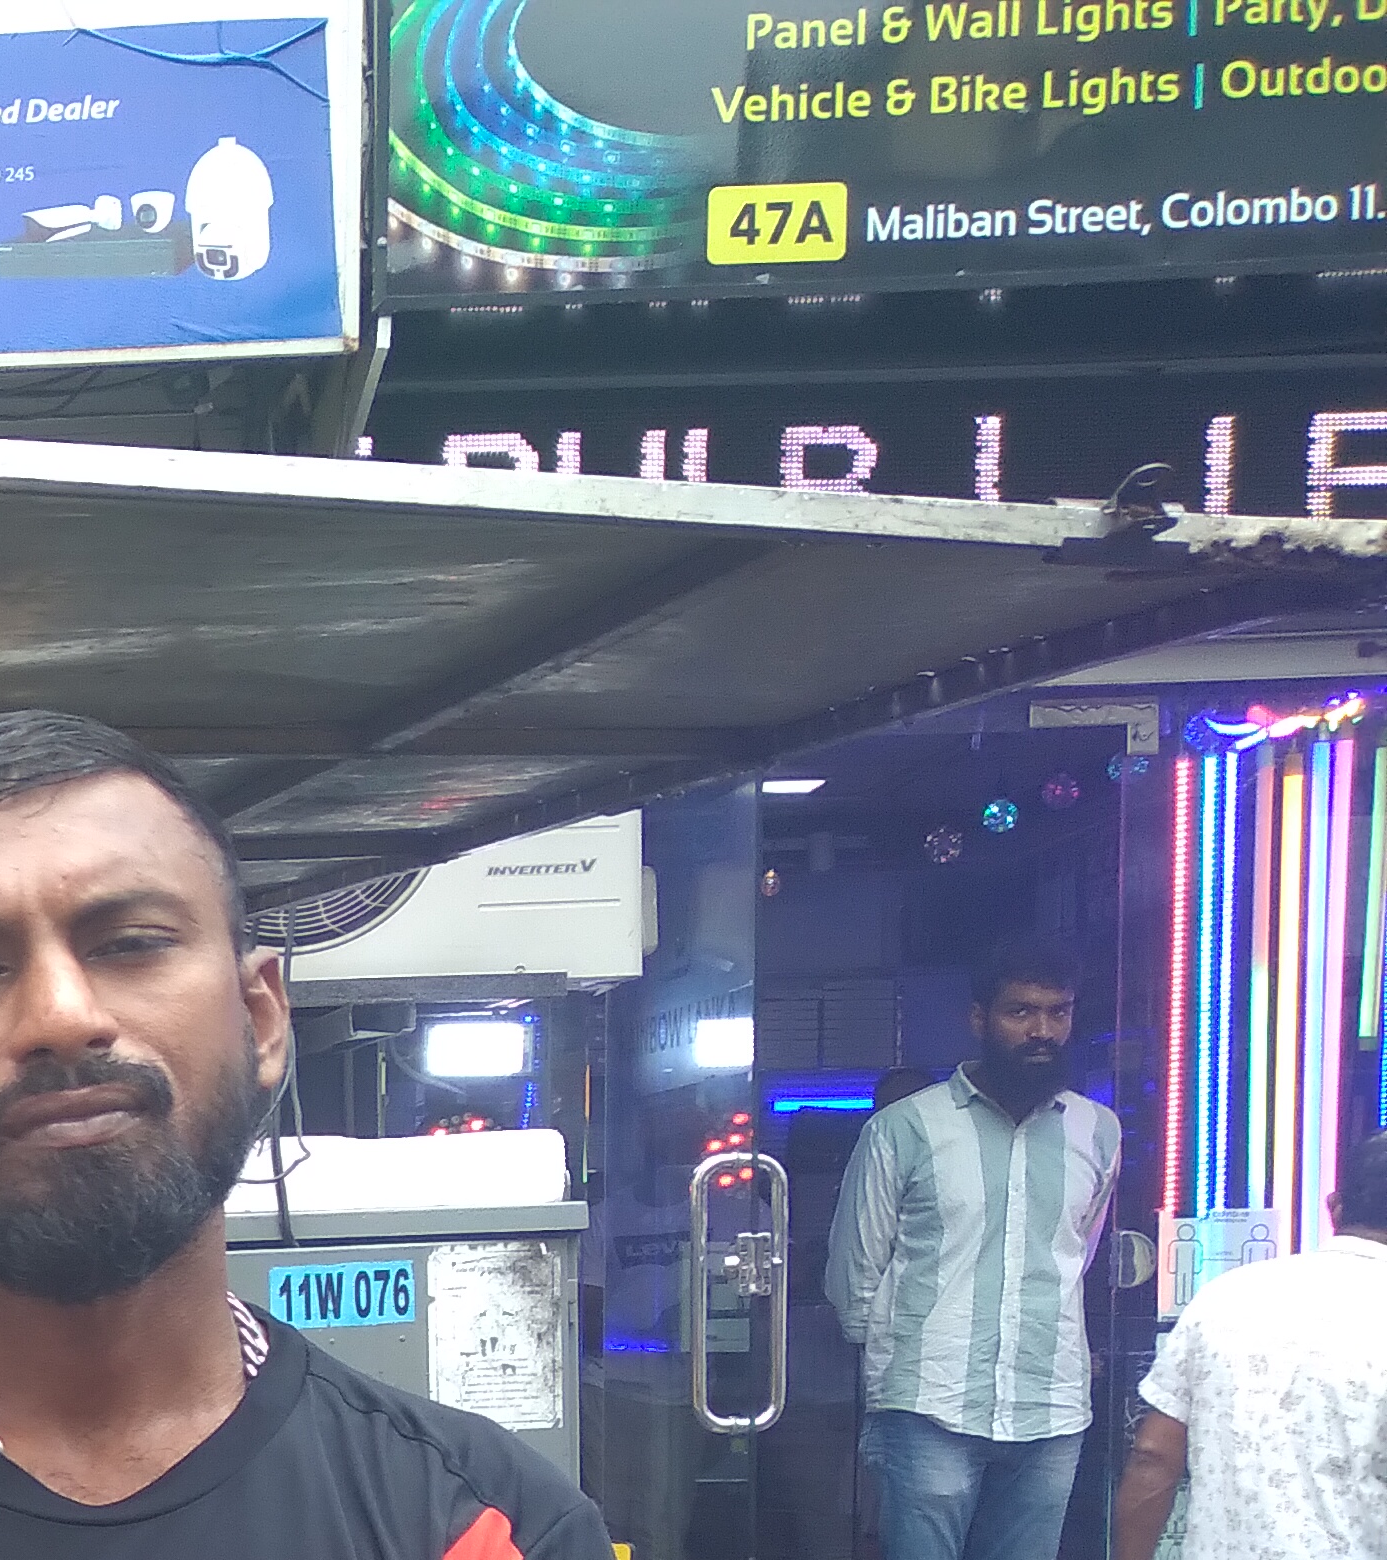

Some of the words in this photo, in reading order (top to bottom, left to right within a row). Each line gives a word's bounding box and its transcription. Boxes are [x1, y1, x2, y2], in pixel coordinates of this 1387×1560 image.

[746, 8, 867, 50] Panel
[882, 6, 912, 44] &
[926, 0, 1020, 42] Wall
[1036, 0, 1174, 42] Lights
[25, 94, 120, 124] Dealer
[711, 82, 872, 123] Vehicle
[886, 78, 916, 117] &
[930, 74, 1027, 115] Bike
[1042, 67, 1180, 115] Lights
[5, 166, 35, 182] 245
[730, 200, 834, 246] 47A
[866, 203, 1017, 242] Maliban
[1028, 199, 1152, 237] Street,
[1162, 186, 1339, 229] Colombo
[487, 863, 578, 876] INVERTER
[279, 1271, 345, 1322] 11W
[354, 1268, 411, 1319] 076
